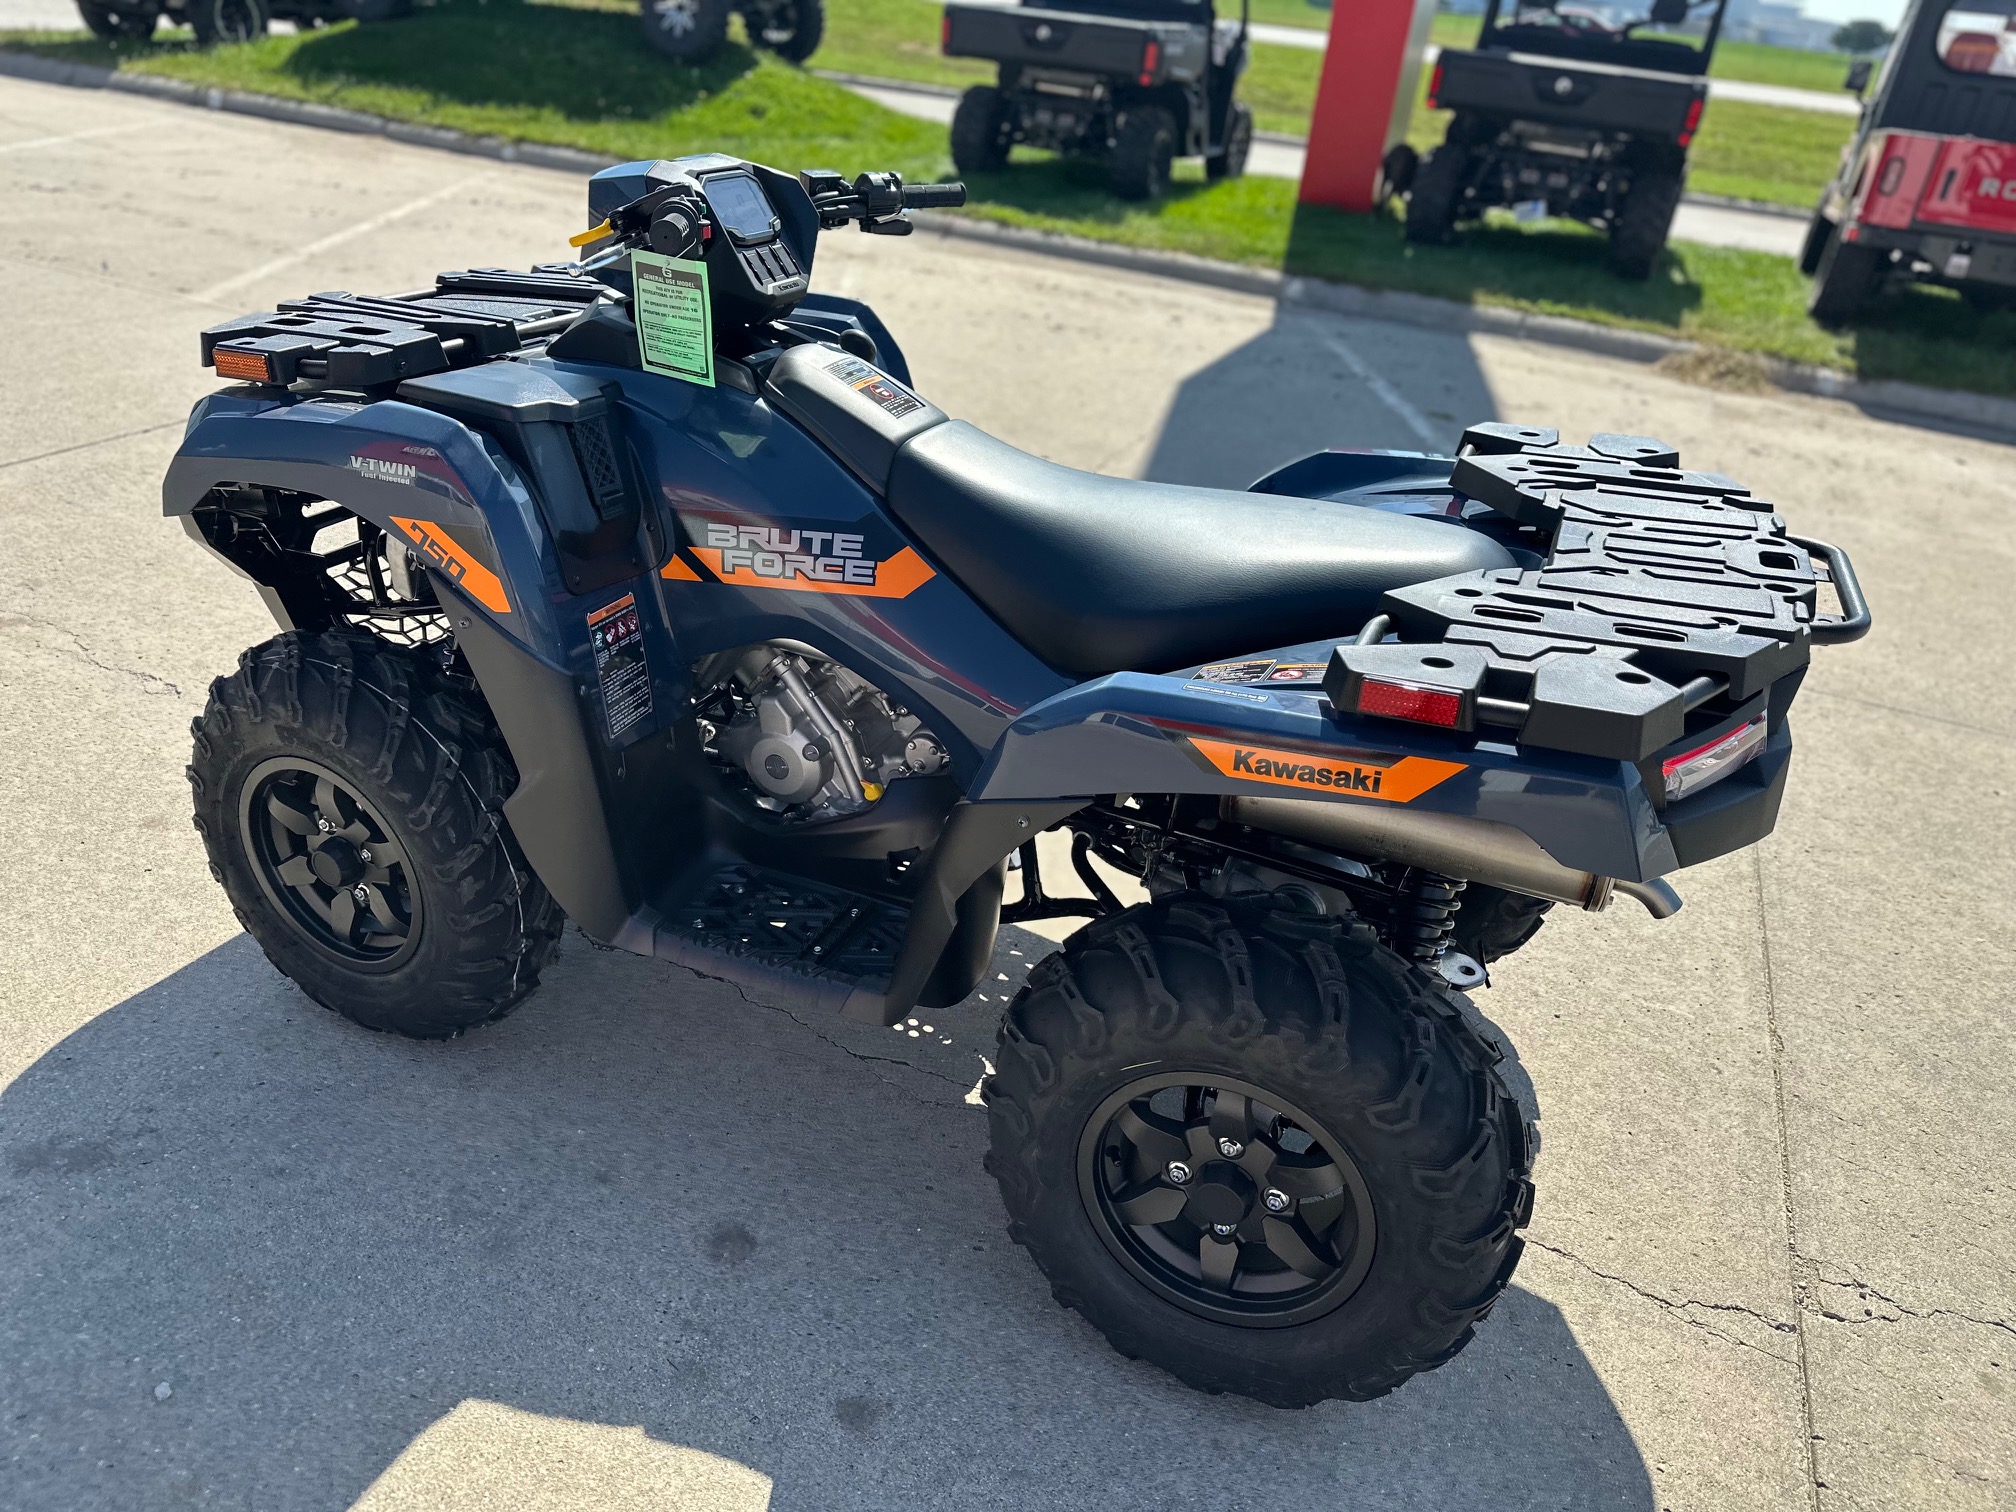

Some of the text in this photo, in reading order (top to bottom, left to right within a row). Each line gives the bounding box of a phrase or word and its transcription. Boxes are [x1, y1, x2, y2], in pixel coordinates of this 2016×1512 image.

[643, 273, 664, 284] GENERAL
[676, 280, 695, 288] MODEL
[350, 456, 416, 478] V-TWIN
[378, 474, 410, 486] Injected
[410, 522, 467, 583] 750
[707, 522, 864, 558] BRUTE
[723, 550, 876, 584] FORCE
[1233, 749, 1382, 794] Kawasaki
